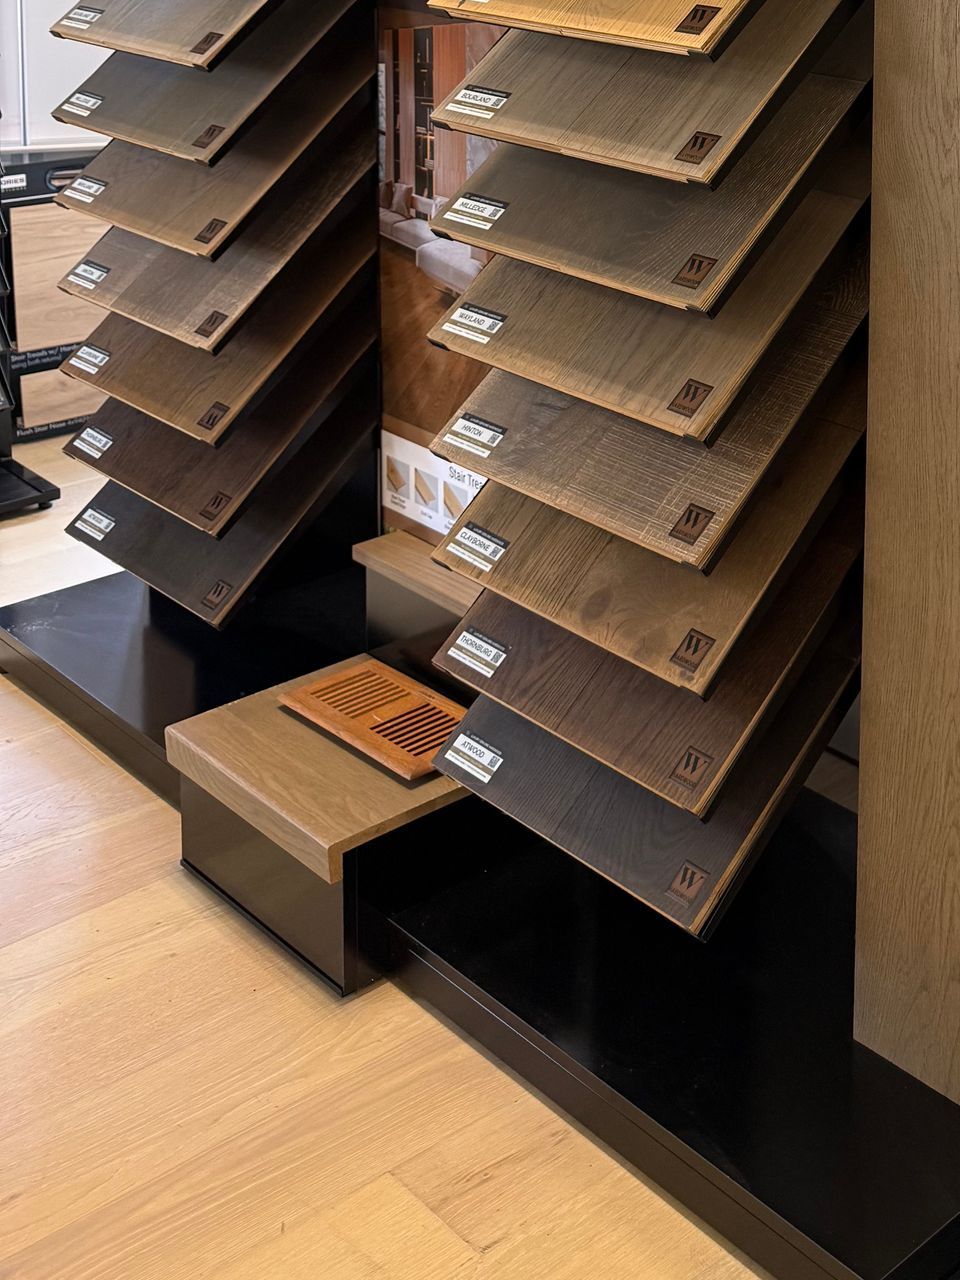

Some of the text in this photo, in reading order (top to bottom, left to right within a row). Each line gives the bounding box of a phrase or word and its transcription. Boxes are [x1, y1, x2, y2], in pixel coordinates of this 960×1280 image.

[460, 92, 491, 103] BOURLAND
[458, 312, 485, 326] WAYLAND
[16, 429, 33, 437] Flush
[461, 424, 483, 437] HINTON
[449, 466, 466, 482] Stair
[460, 531, 491, 551] CLAYBORNE
[460, 634, 493, 657] THORNBURG
[461, 740, 485, 758] ATWOOD
